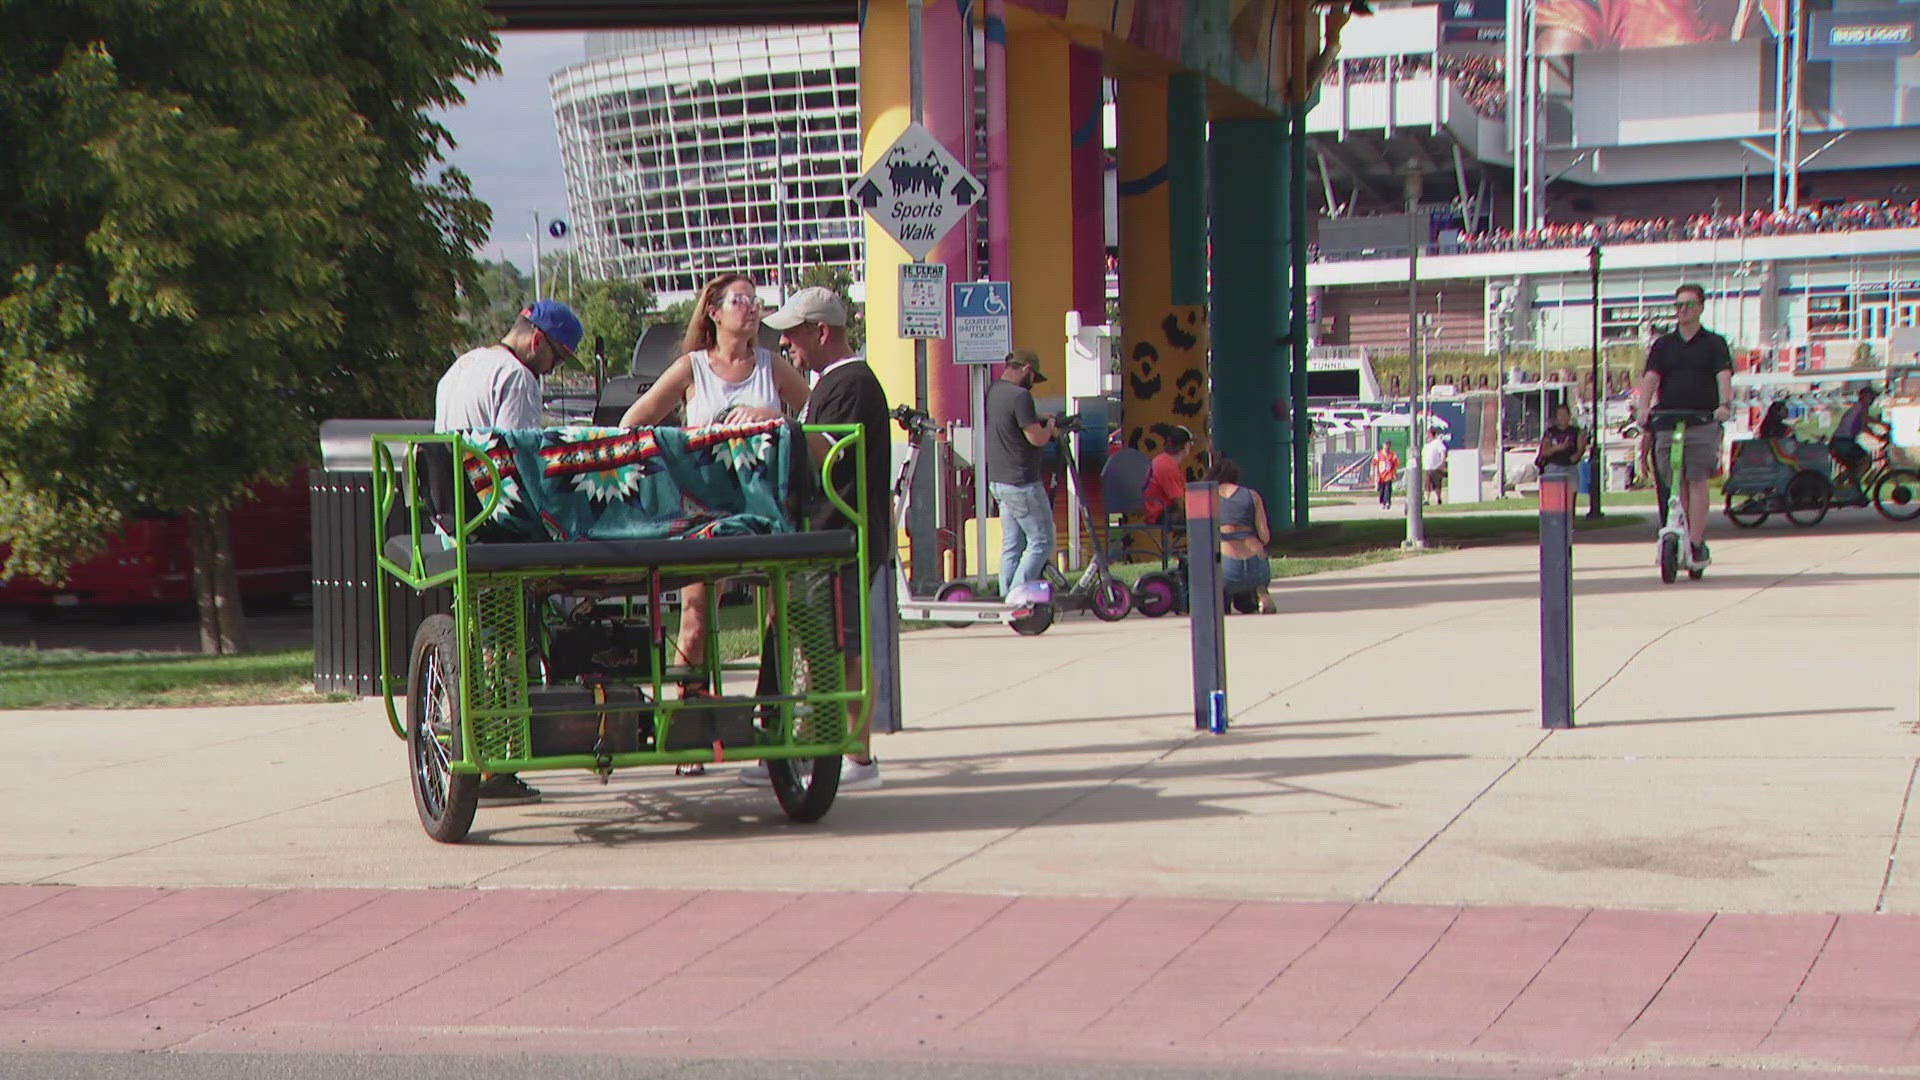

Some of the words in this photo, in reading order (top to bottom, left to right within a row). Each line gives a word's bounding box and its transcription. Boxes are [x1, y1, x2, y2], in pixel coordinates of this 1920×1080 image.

[891, 201, 943, 221] Sports
[900, 223, 936, 240] Walk
[959, 286, 974, 308] 7
